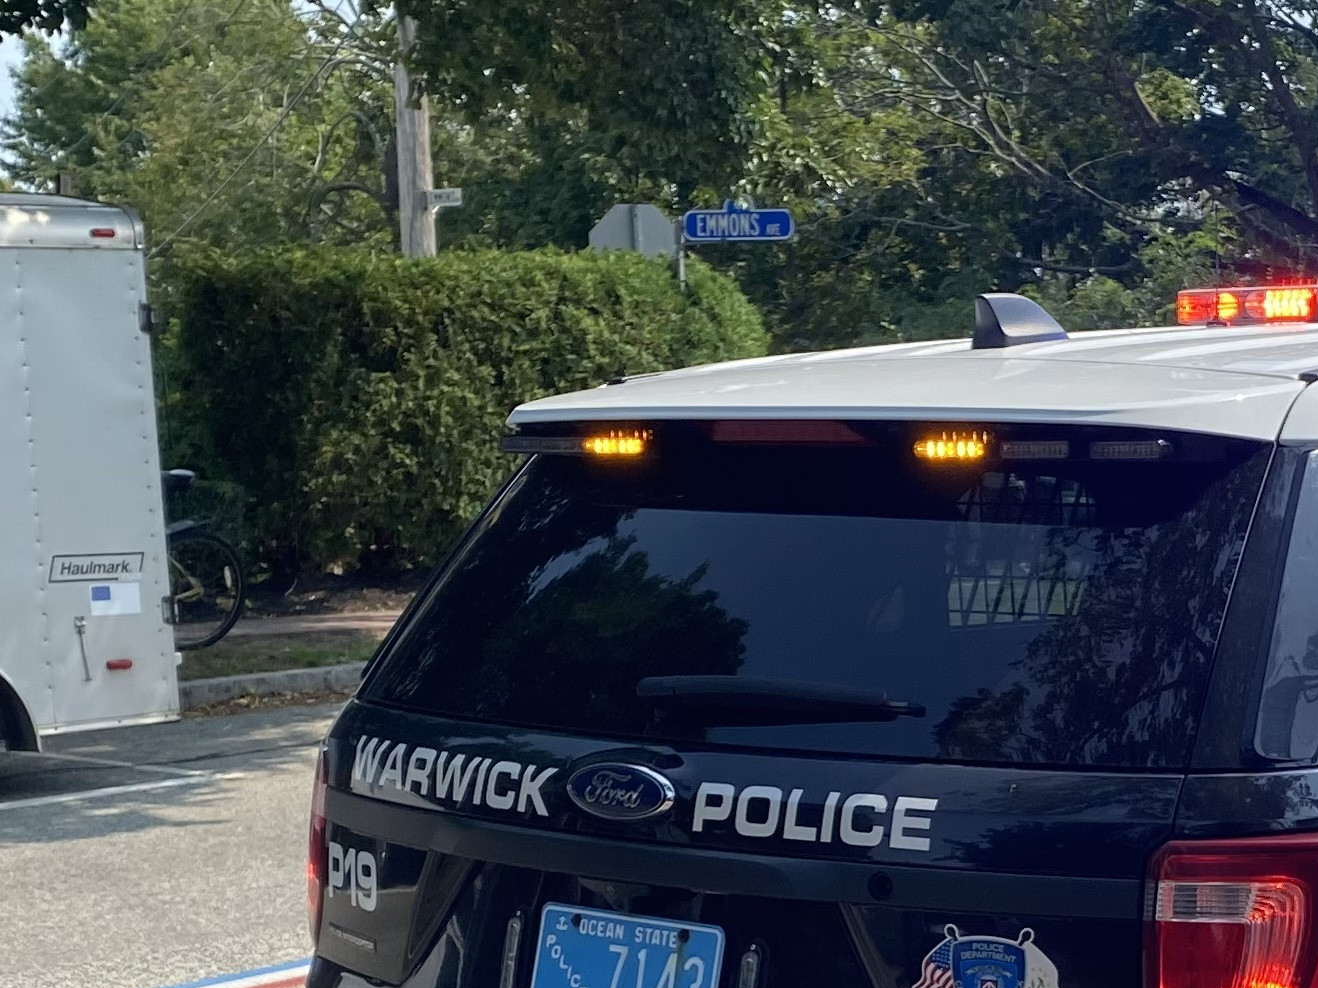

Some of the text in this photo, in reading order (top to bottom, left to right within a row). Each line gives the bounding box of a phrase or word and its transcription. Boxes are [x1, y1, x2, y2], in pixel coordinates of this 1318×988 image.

[696, 214, 781, 236] EMMONS AVE
[60, 560, 130, 575] Haulmark
[351, 735, 939, 852] WARWICK POLICE
[584, 771, 645, 808] Ford
[328, 841, 377, 912] P19
[579, 918, 678, 948] OCEAN STATE
[961, 950, 1017, 963] DEPARTMENT
[972, 942, 1005, 953] POLICE
